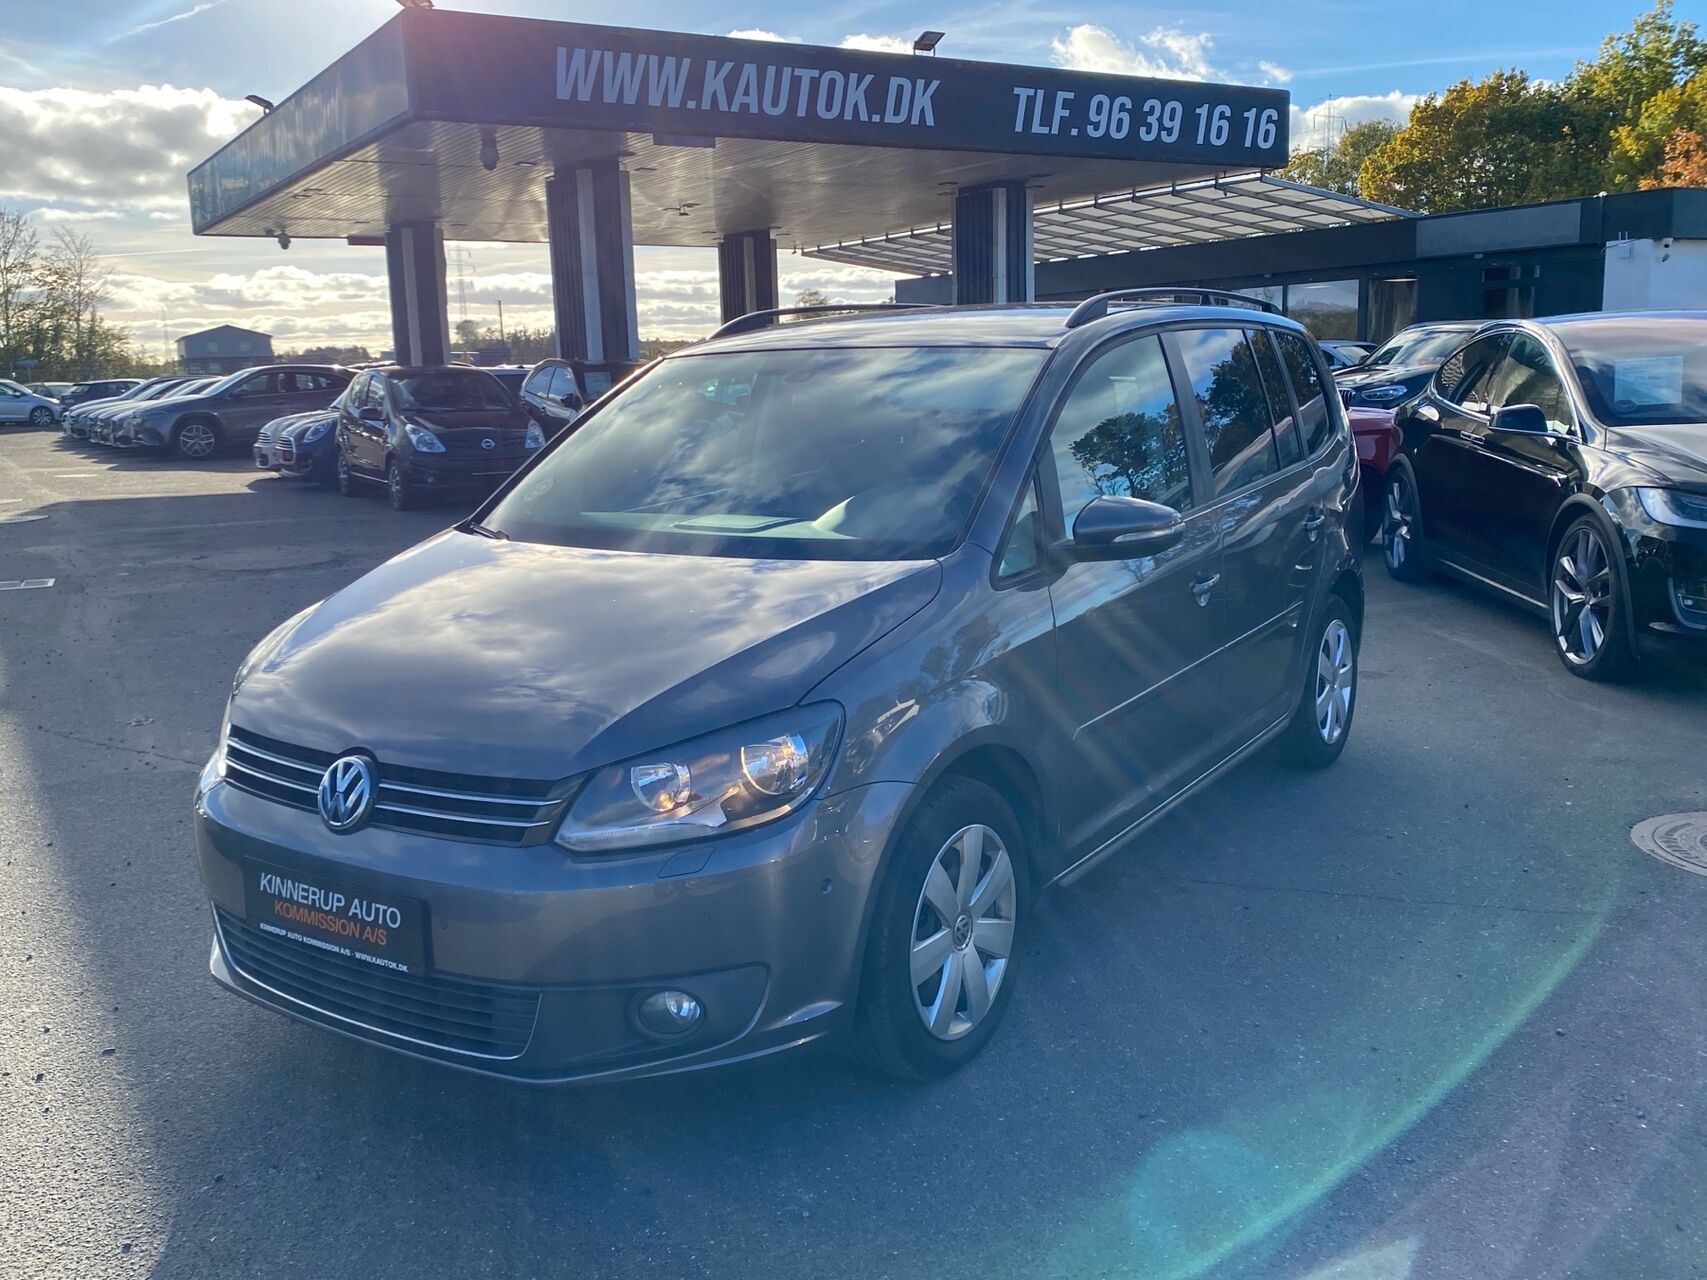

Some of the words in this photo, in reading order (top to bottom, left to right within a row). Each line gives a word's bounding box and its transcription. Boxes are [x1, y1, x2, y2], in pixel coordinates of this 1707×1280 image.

[555, 46, 941, 127] WWW.KAUTOK.DK
[1013, 86, 1079, 136] TLF.
[1087, 93, 1133, 140] 96
[1139, 98, 1183, 144] 39
[1195, 103, 1232, 147] 16
[1242, 107, 1279, 150] 16
[259, 872, 345, 913] KINNERUP
[348, 898, 401, 929] AUTO
[274, 899, 360, 939] KOMMISSION
[363, 925, 387, 946] A/S
[287, 932, 303, 942] AUTO
[354, 951, 409, 973] WWW.KAUTOK.DK
